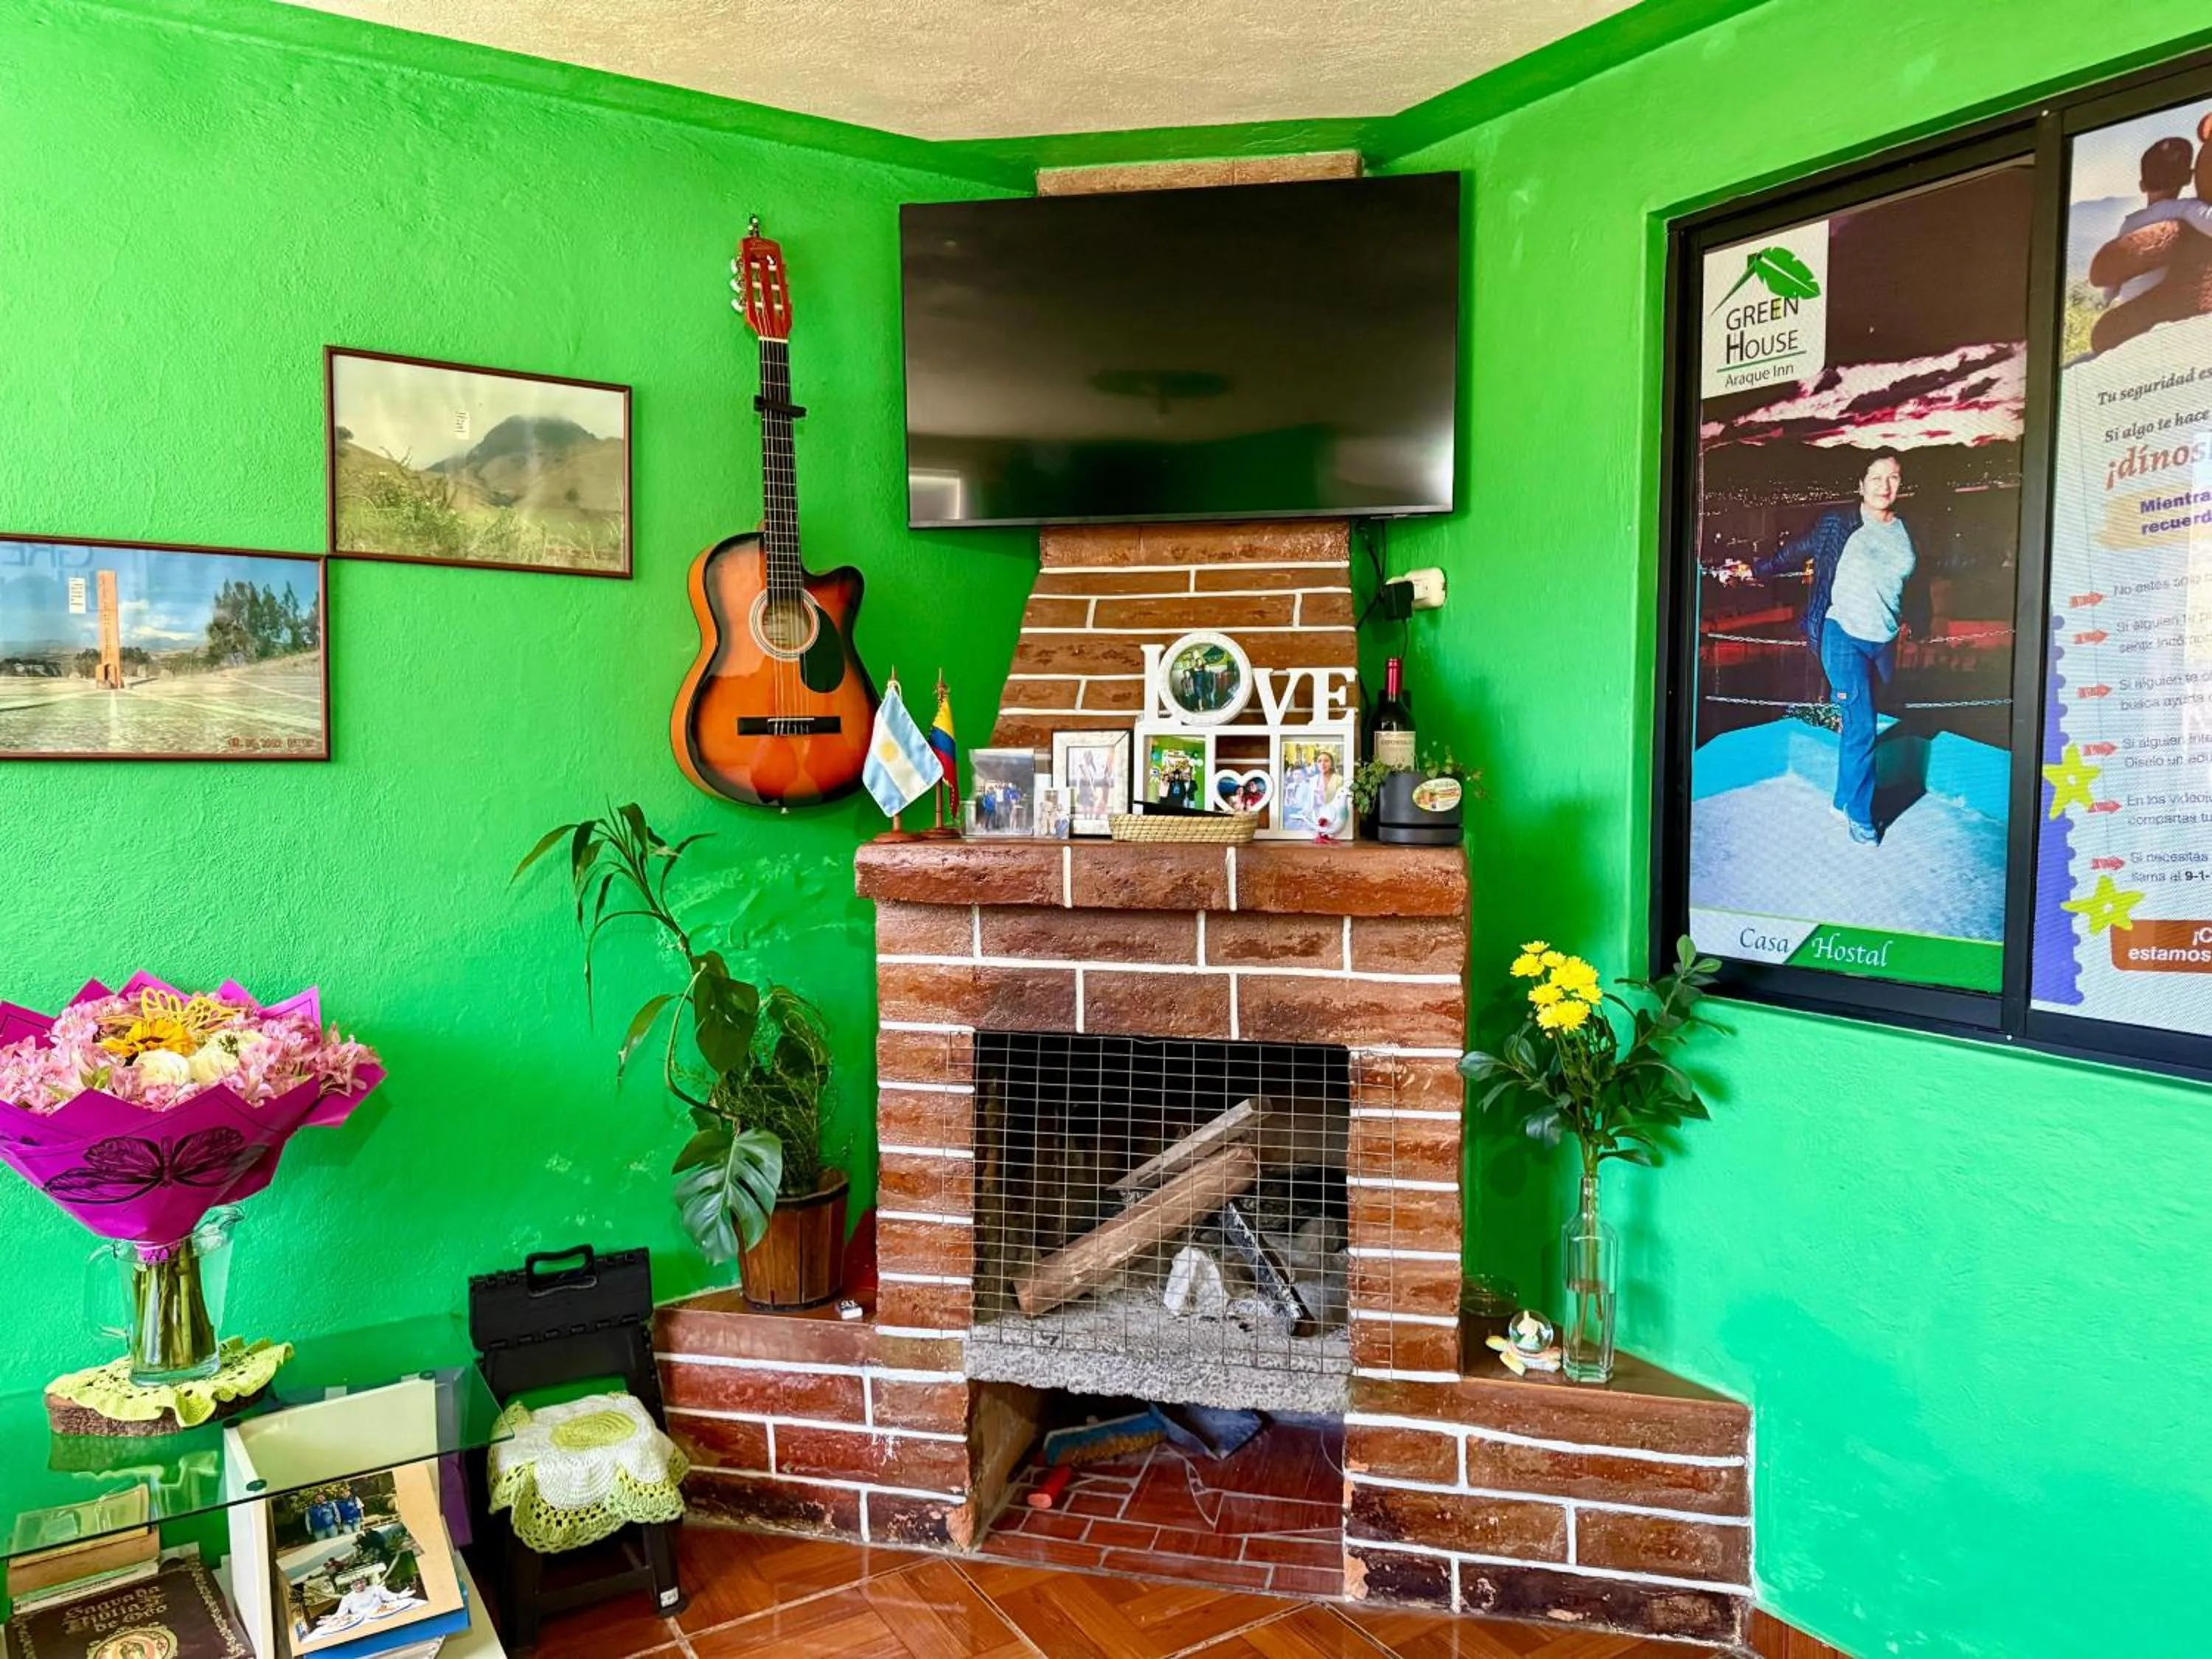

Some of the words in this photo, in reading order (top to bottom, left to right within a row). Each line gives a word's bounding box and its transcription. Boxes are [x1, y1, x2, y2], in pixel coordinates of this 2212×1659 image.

[1726, 295, 1798, 330] GREEN
[1725, 368, 1770, 387] Araque
[1773, 364, 1794, 377] Inn
[2098, 392, 2117, 406] Tu
[2120, 367, 2194, 400] seguridad
[2105, 427, 2118, 442] Si
[2122, 422, 2154, 439] algo
[2157, 418, 2171, 431] te
[2175, 409, 2210, 426] hace
[2140, 491, 2212, 513] Mientra
[1140, 632, 1358, 726] LOVE
[2127, 794, 2143, 807] En
[2147, 793, 2166, 805] los
[2128, 813, 2197, 826] compartas
[2130, 852, 2143, 864] Si
[2146, 851, 2208, 863] necesitas
[1739, 926, 1791, 953] Casa
[1811, 932, 1894, 968] Hostal
[2128, 947, 2212, 962] estamos
